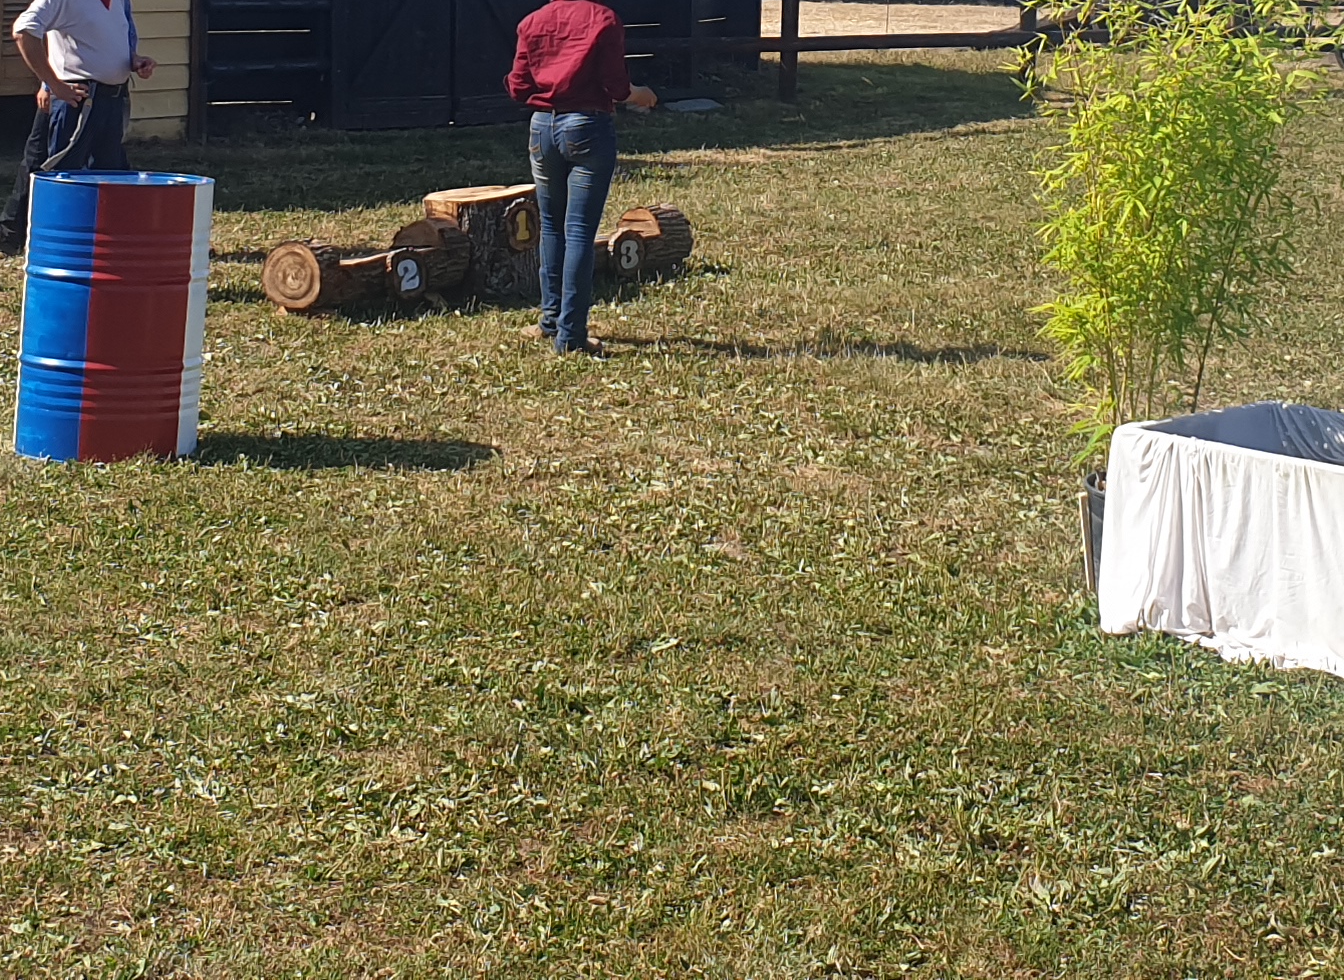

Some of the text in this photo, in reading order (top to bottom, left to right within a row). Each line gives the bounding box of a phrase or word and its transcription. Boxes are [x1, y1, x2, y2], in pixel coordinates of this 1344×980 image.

[515, 210, 530, 241] 1
[620, 240, 639, 270] 3
[397, 259, 420, 292] 2
